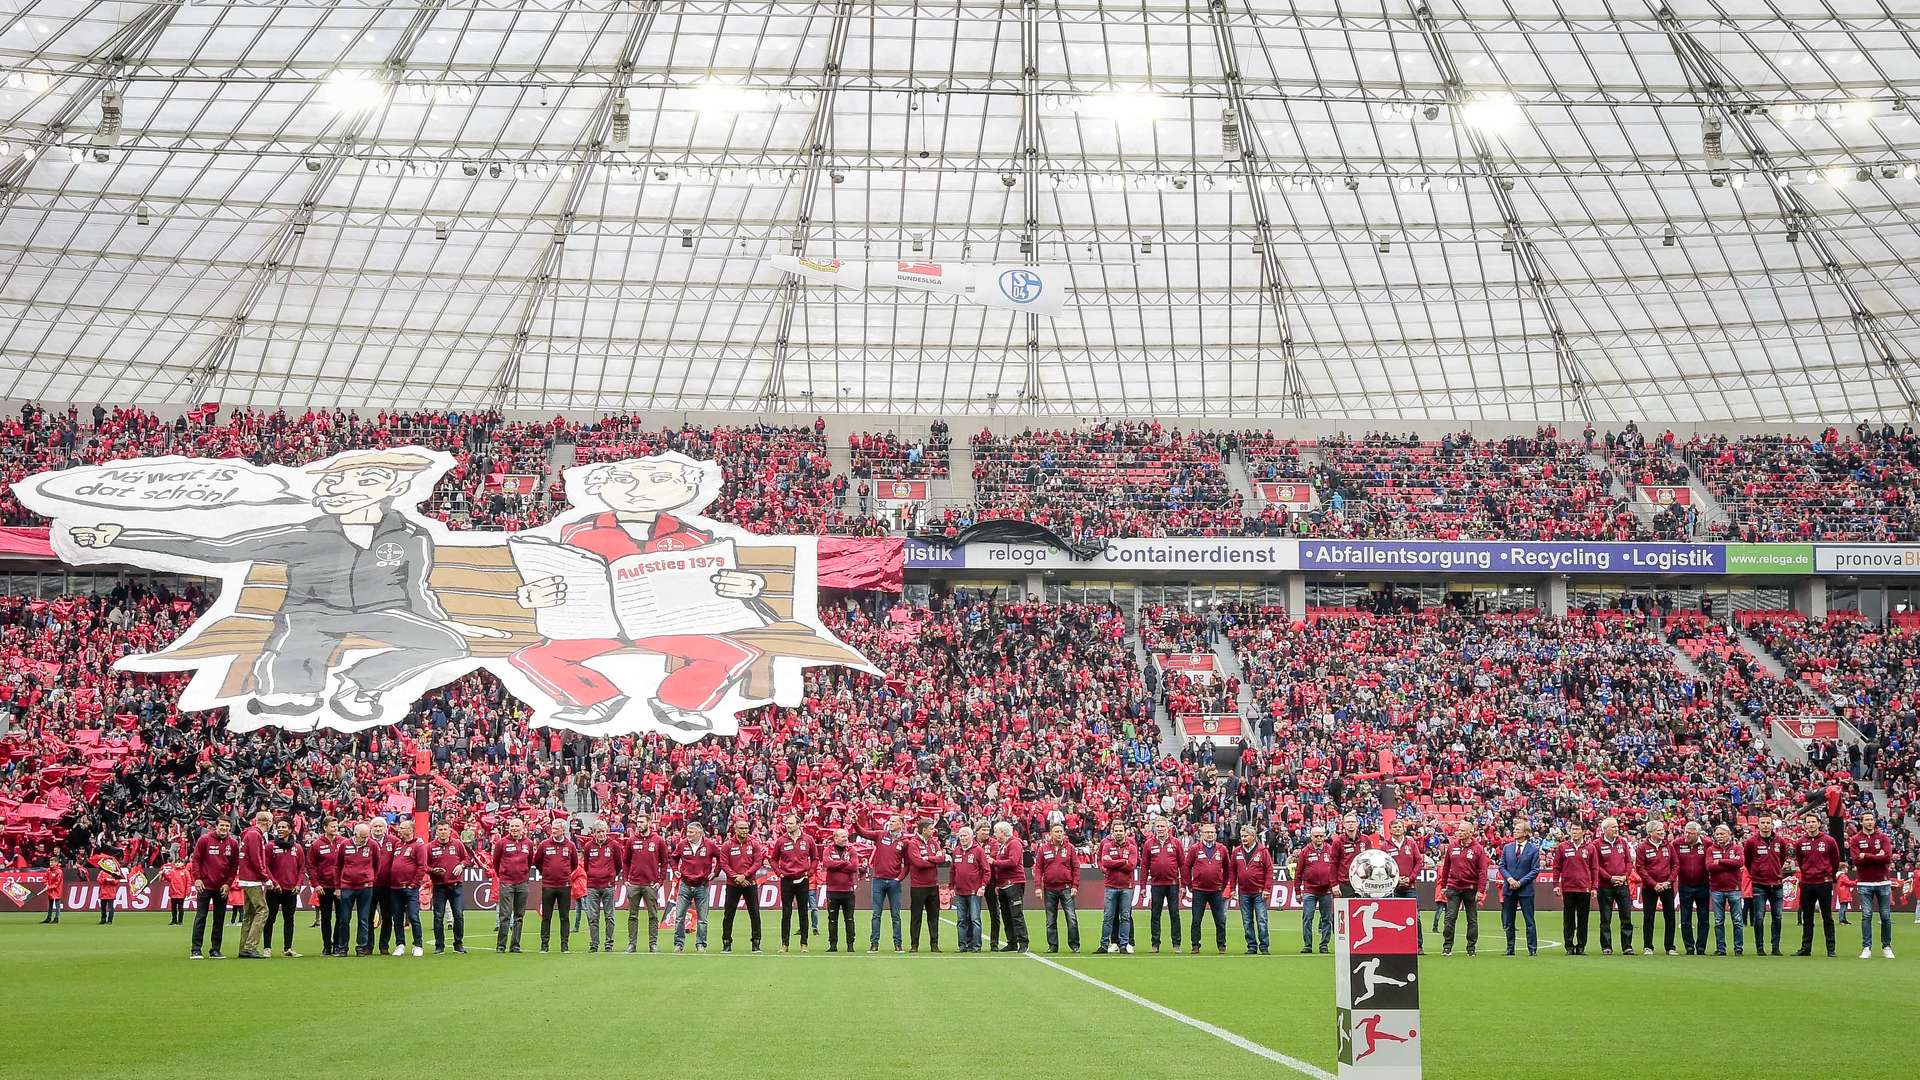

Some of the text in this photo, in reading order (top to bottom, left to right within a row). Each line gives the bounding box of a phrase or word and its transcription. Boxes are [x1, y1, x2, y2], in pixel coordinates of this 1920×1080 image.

[897, 274, 942, 285] BUNDESLIGA
[74, 482, 239, 503] dat schön!
[989, 544, 1047, 565] reloga
[1103, 545, 1276, 563] Containerdienst
[1315, 546, 1714, 570] Abfallentsorgung Recycling Logistik
[1730, 554, 1809, 566] www.reloga.de
[616, 556, 726, 581] Aufstieg 1979
